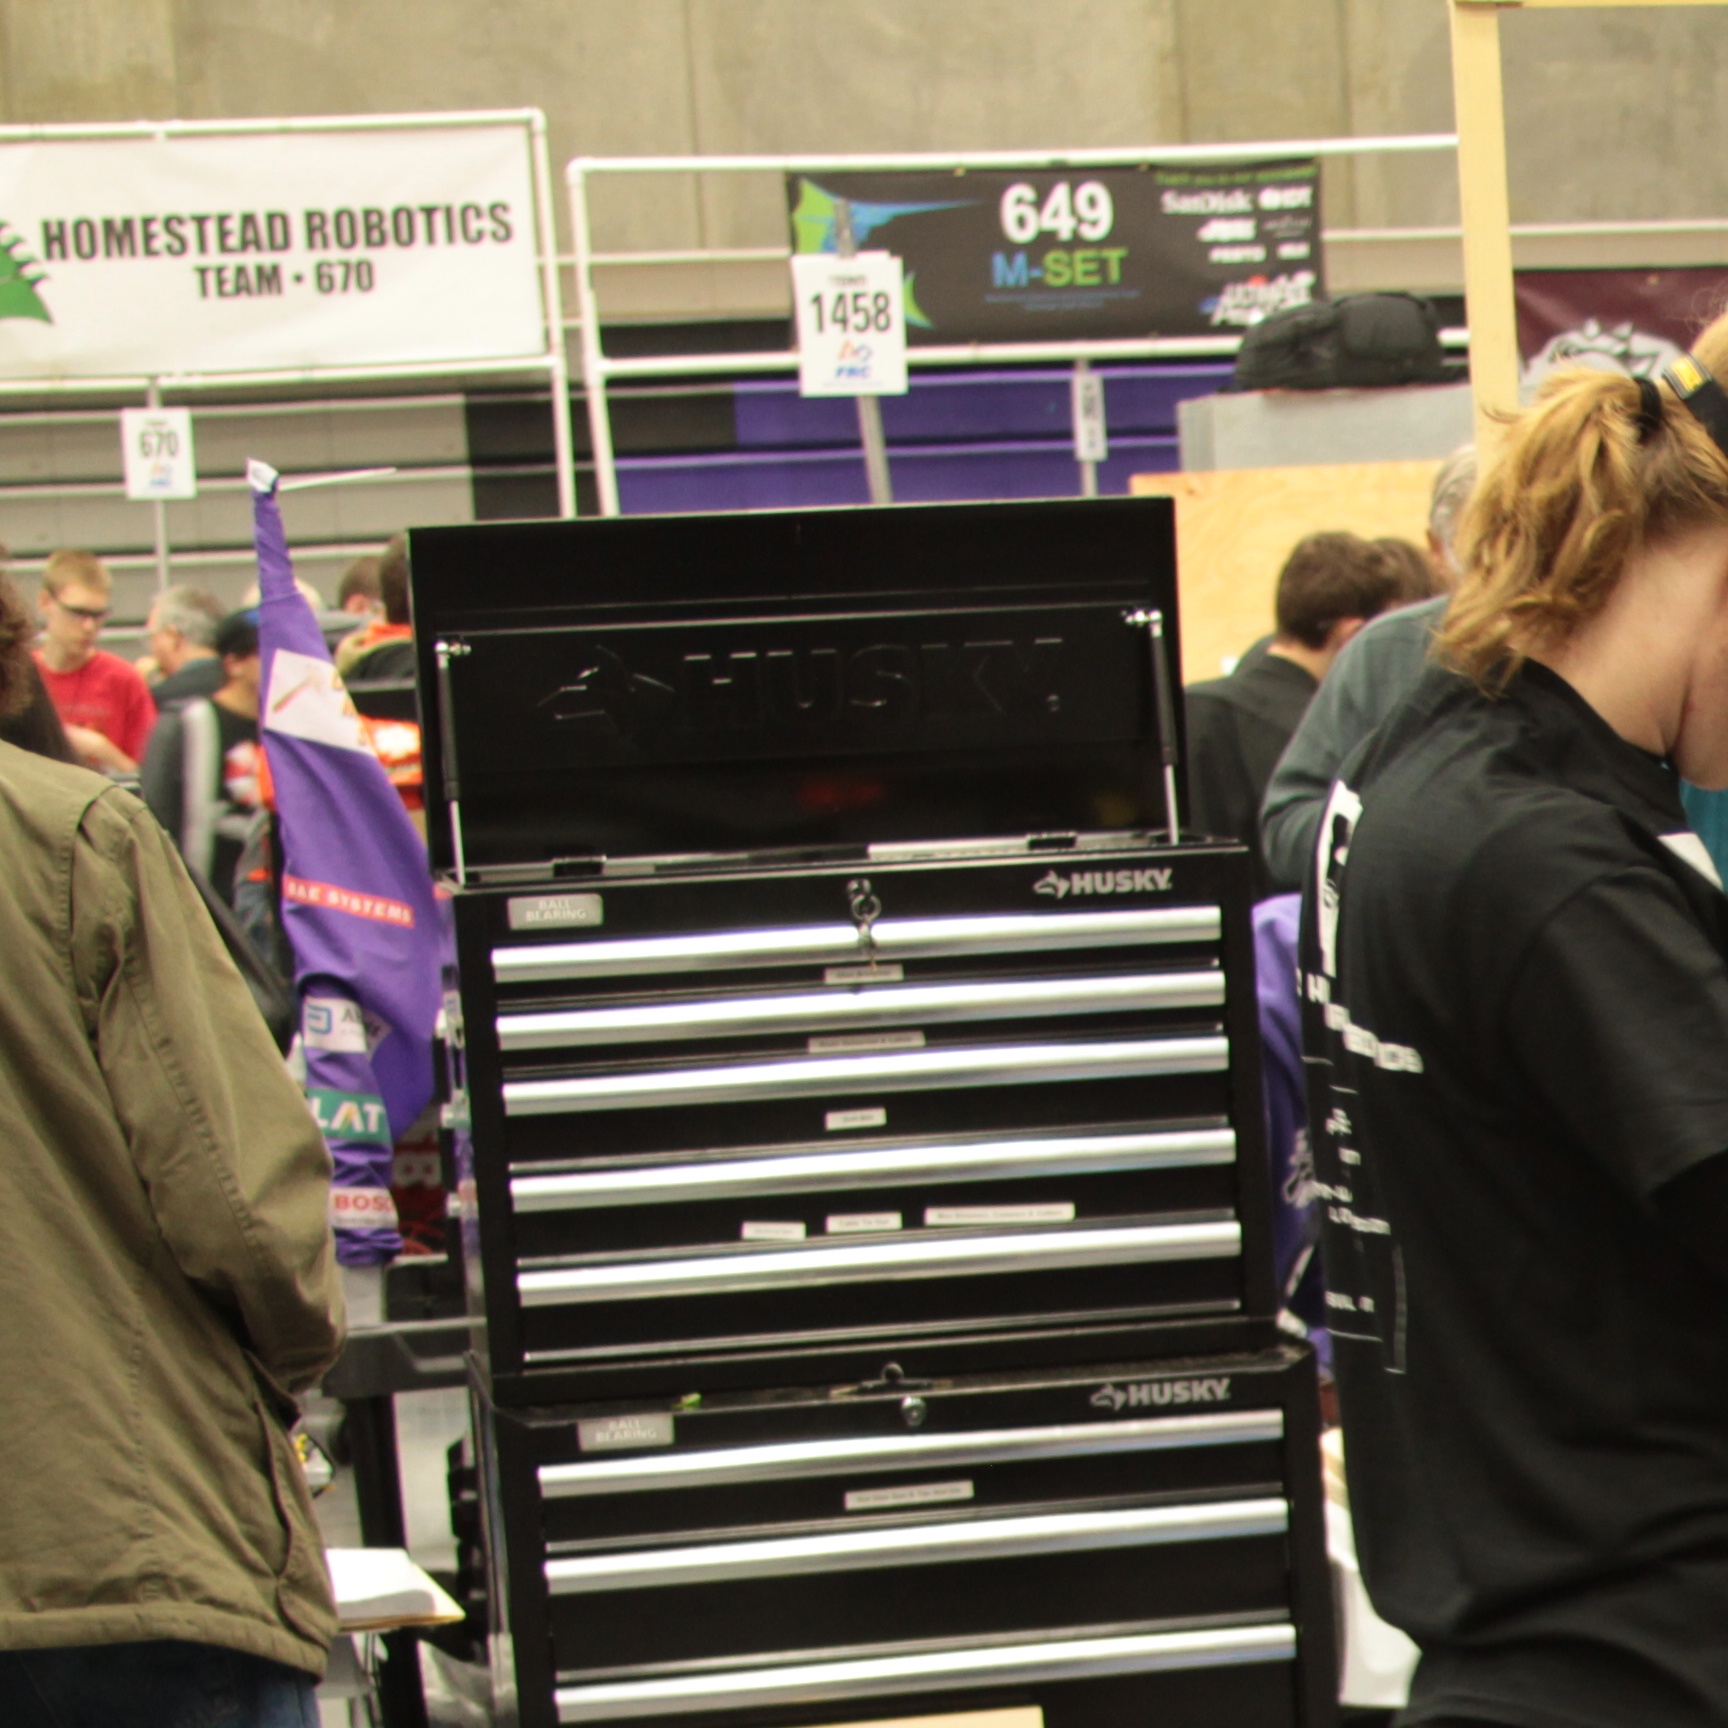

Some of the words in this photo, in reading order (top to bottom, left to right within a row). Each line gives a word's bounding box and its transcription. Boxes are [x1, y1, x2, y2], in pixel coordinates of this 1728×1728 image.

[1001, 180, 1114, 244] 649
[41, 210, 291, 262] HOMESTEAD
[305, 202, 513, 251] ROBOTICS
[194, 263, 282, 299] TEAM
[315, 259, 374, 295] 670
[991, 247, 1130, 288] M-SET
[810, 291, 890, 333] 1458
[137, 429, 179, 459] 670
[1071, 868, 1173, 896] HUSKY
[329, 889, 414, 924] SYSTEMS
[525, 908, 587, 922] BEARING
[1127, 1376, 1231, 1408] HUSKY
